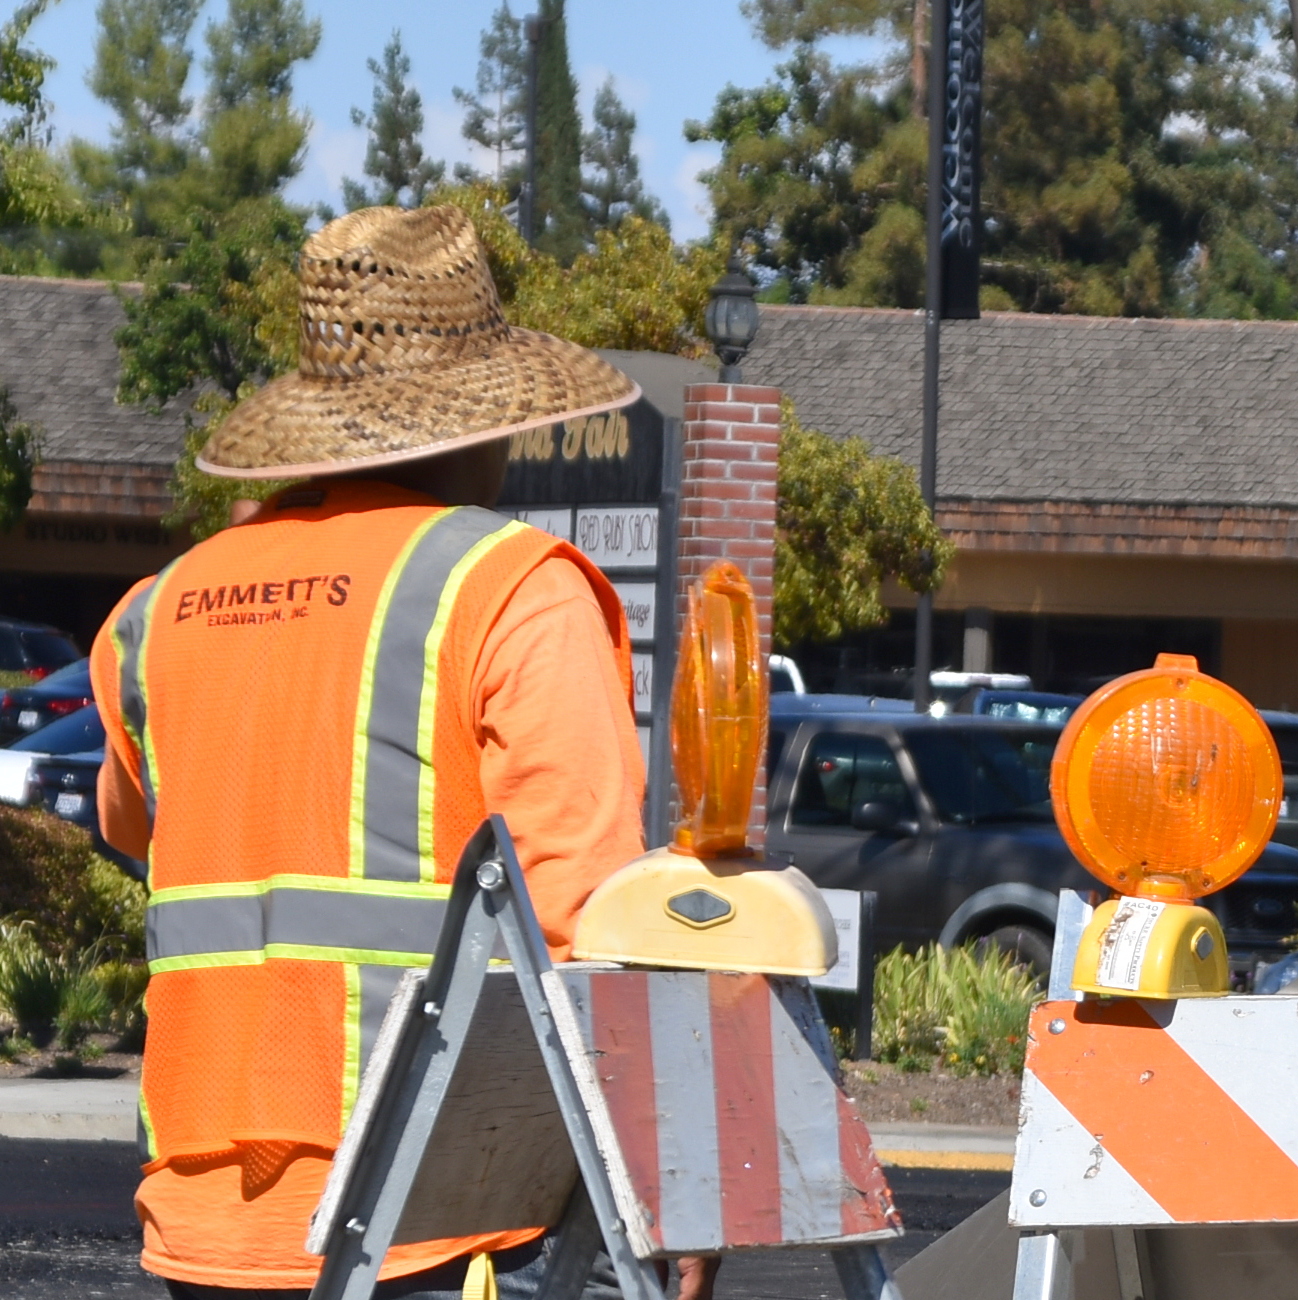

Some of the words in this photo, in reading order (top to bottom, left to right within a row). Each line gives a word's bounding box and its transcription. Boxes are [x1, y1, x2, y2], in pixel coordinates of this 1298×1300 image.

[25, 520, 107, 543] STUDIO
[580, 514, 600, 551] RED
[603, 514, 626, 555] RUBY
[627, 513, 658, 557] SALON
[175, 574, 351, 624] EMMETT'S
